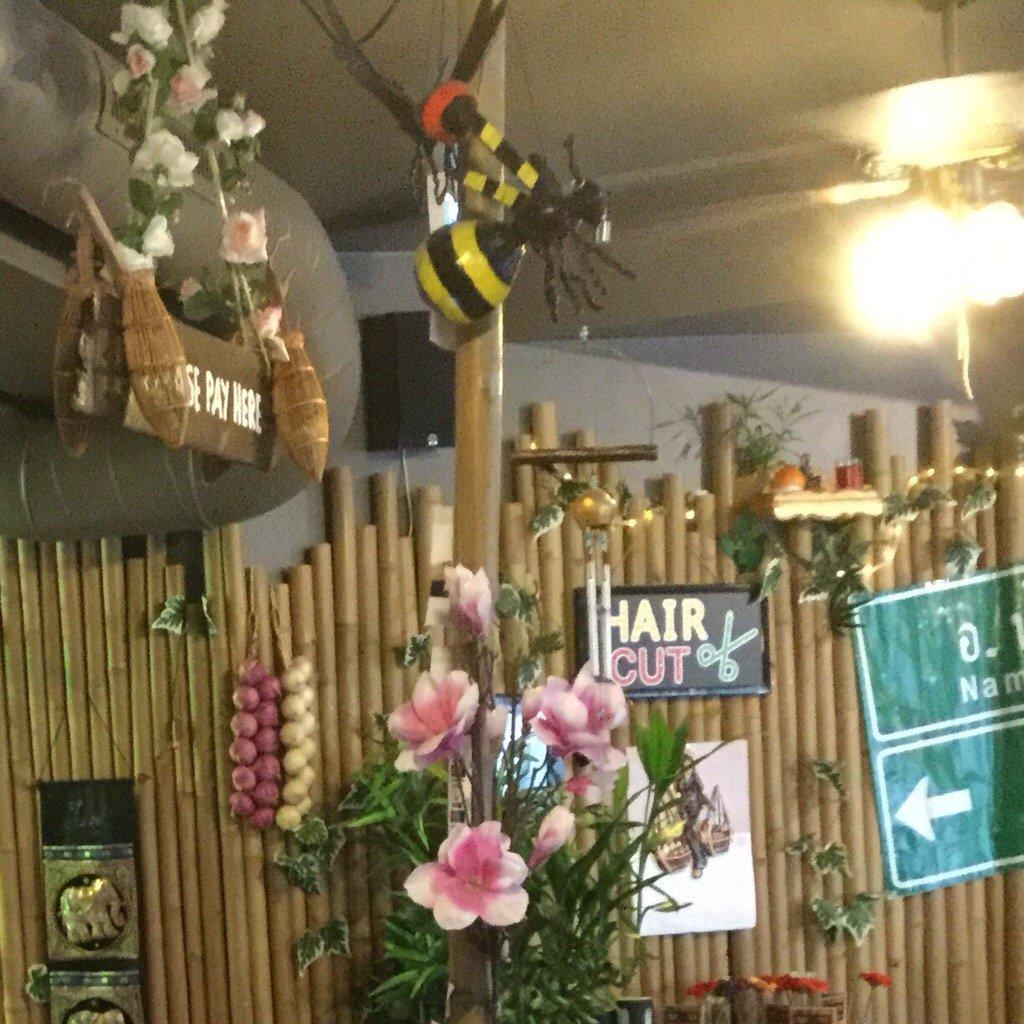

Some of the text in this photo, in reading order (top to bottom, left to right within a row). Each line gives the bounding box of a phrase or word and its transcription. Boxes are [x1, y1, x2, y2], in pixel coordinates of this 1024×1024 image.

[205, 369, 229, 421] PAY
[233, 380, 262, 434] HERE
[610, 598, 709, 643] HAIR
[611, 646, 691, 687] CUT
